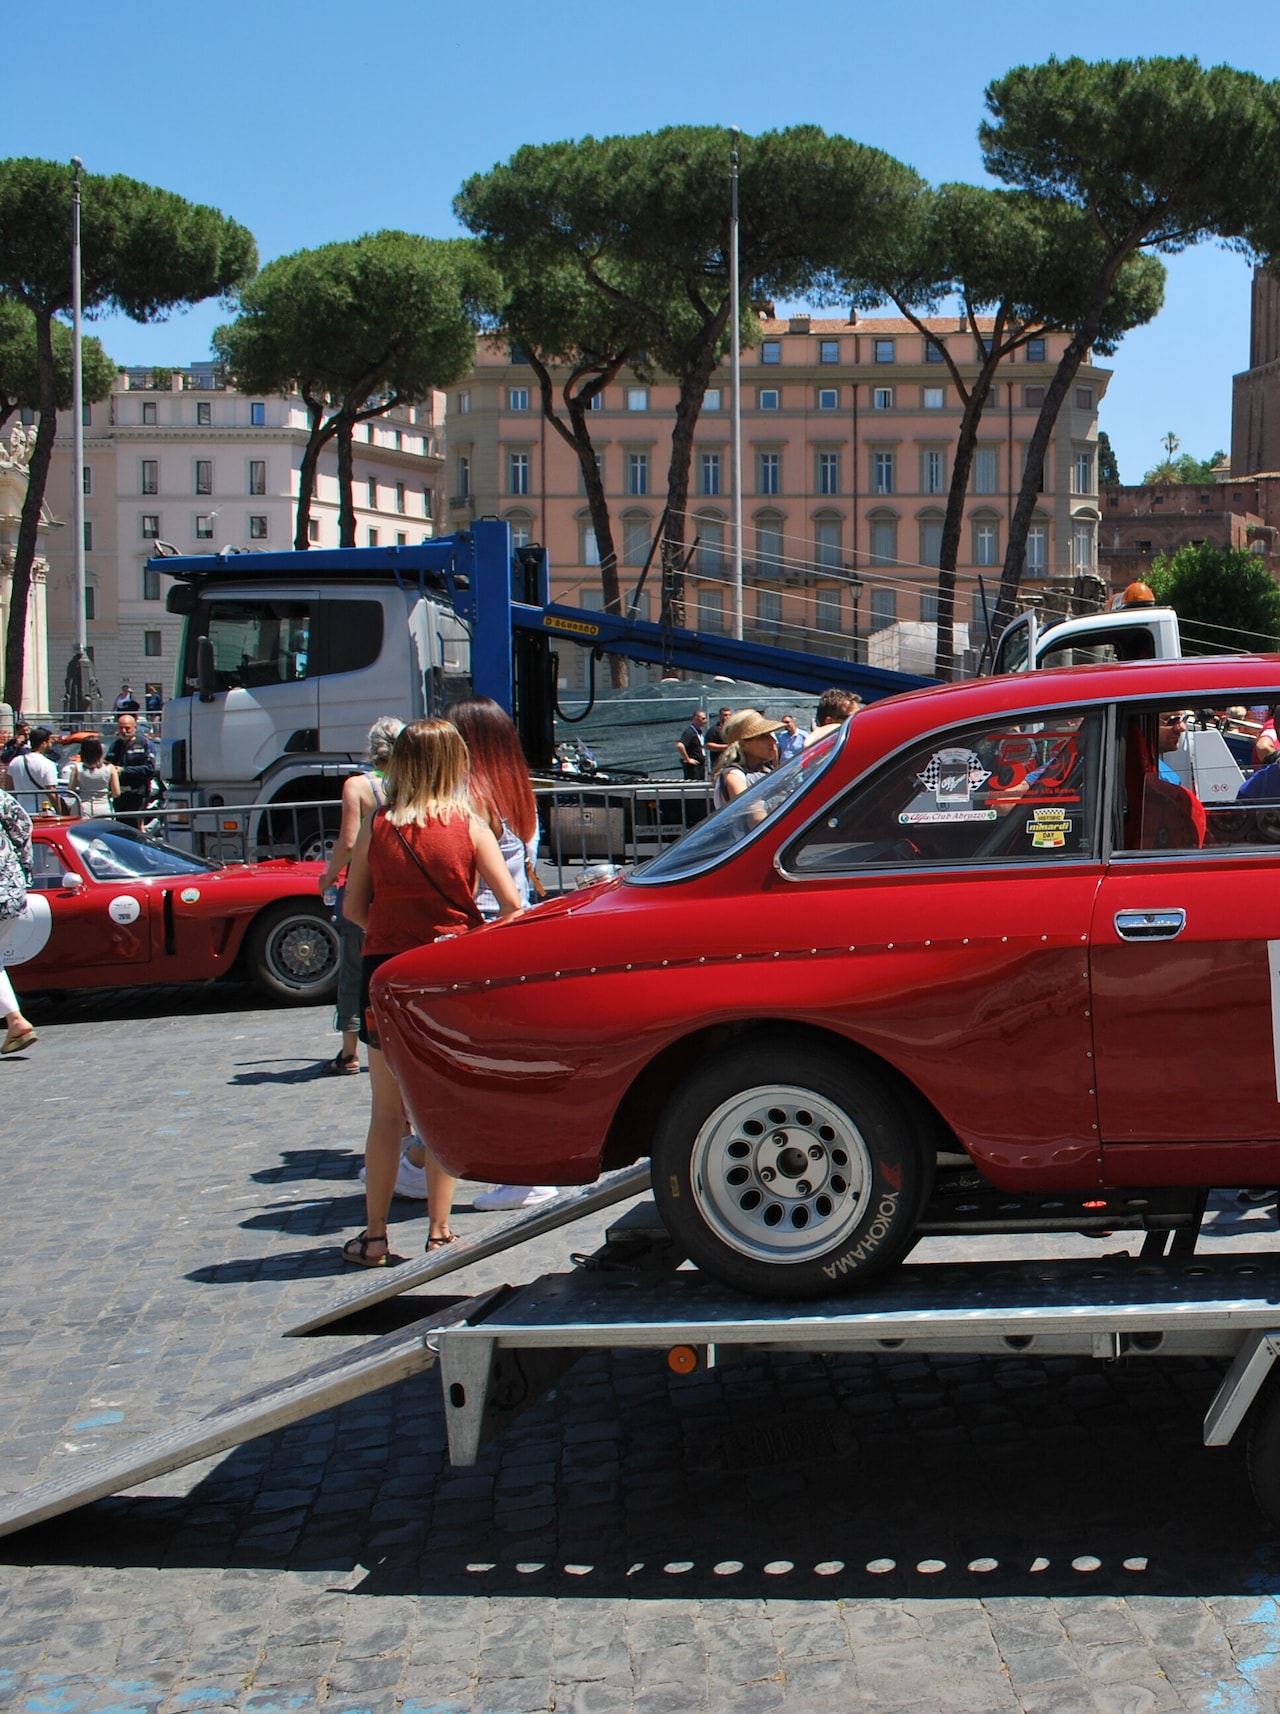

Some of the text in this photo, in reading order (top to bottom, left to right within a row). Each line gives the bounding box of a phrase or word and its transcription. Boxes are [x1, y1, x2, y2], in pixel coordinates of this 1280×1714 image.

[931, 812, 952, 820] Club
[952, 811, 987, 819] Abruzzo
[1028, 822, 1069, 831] minardi
[822, 1191, 899, 1279] YOKOHAMA
